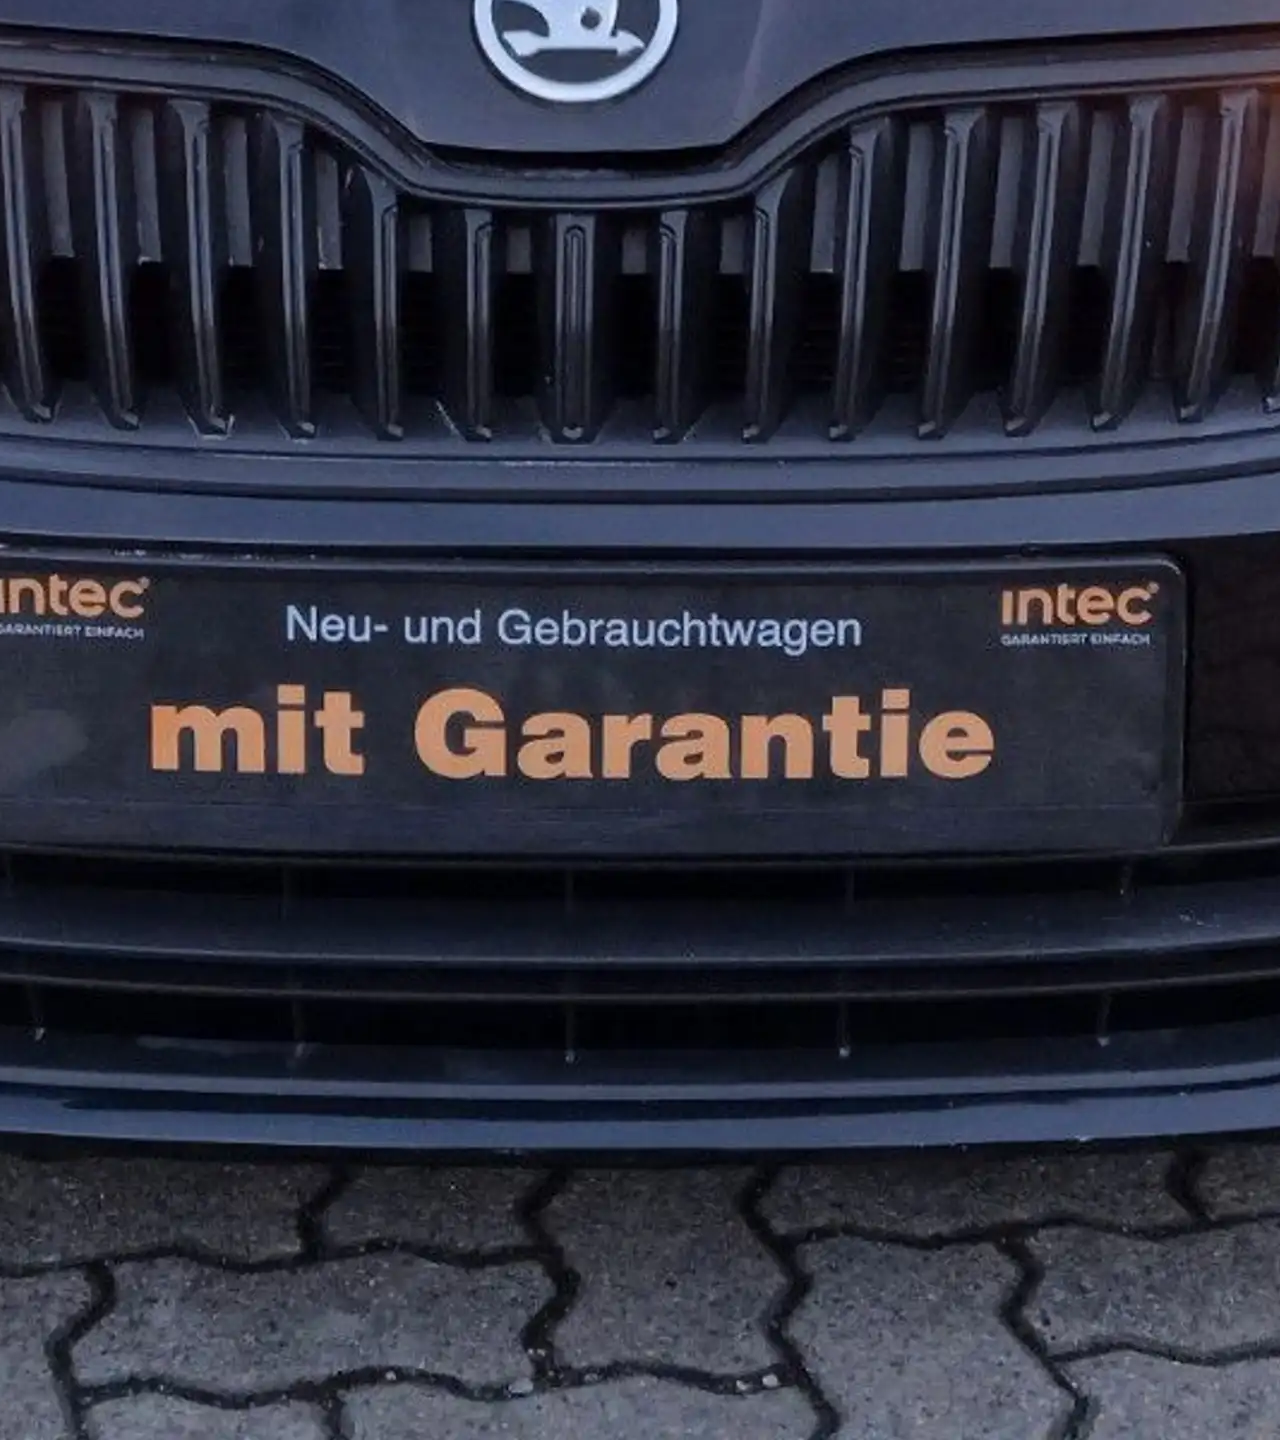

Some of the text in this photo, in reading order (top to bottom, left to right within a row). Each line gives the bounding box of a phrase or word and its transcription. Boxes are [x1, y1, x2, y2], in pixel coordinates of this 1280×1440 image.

[1001, 582, 1154, 627] intec
[85, 624, 145, 641] EINFACH
[286, 605, 863, 656] Neu- und Gebrauchtwagen
[1000, 632, 1151, 647] GARANTIERT EINFACH
[151, 683, 995, 780] mit Garantie
